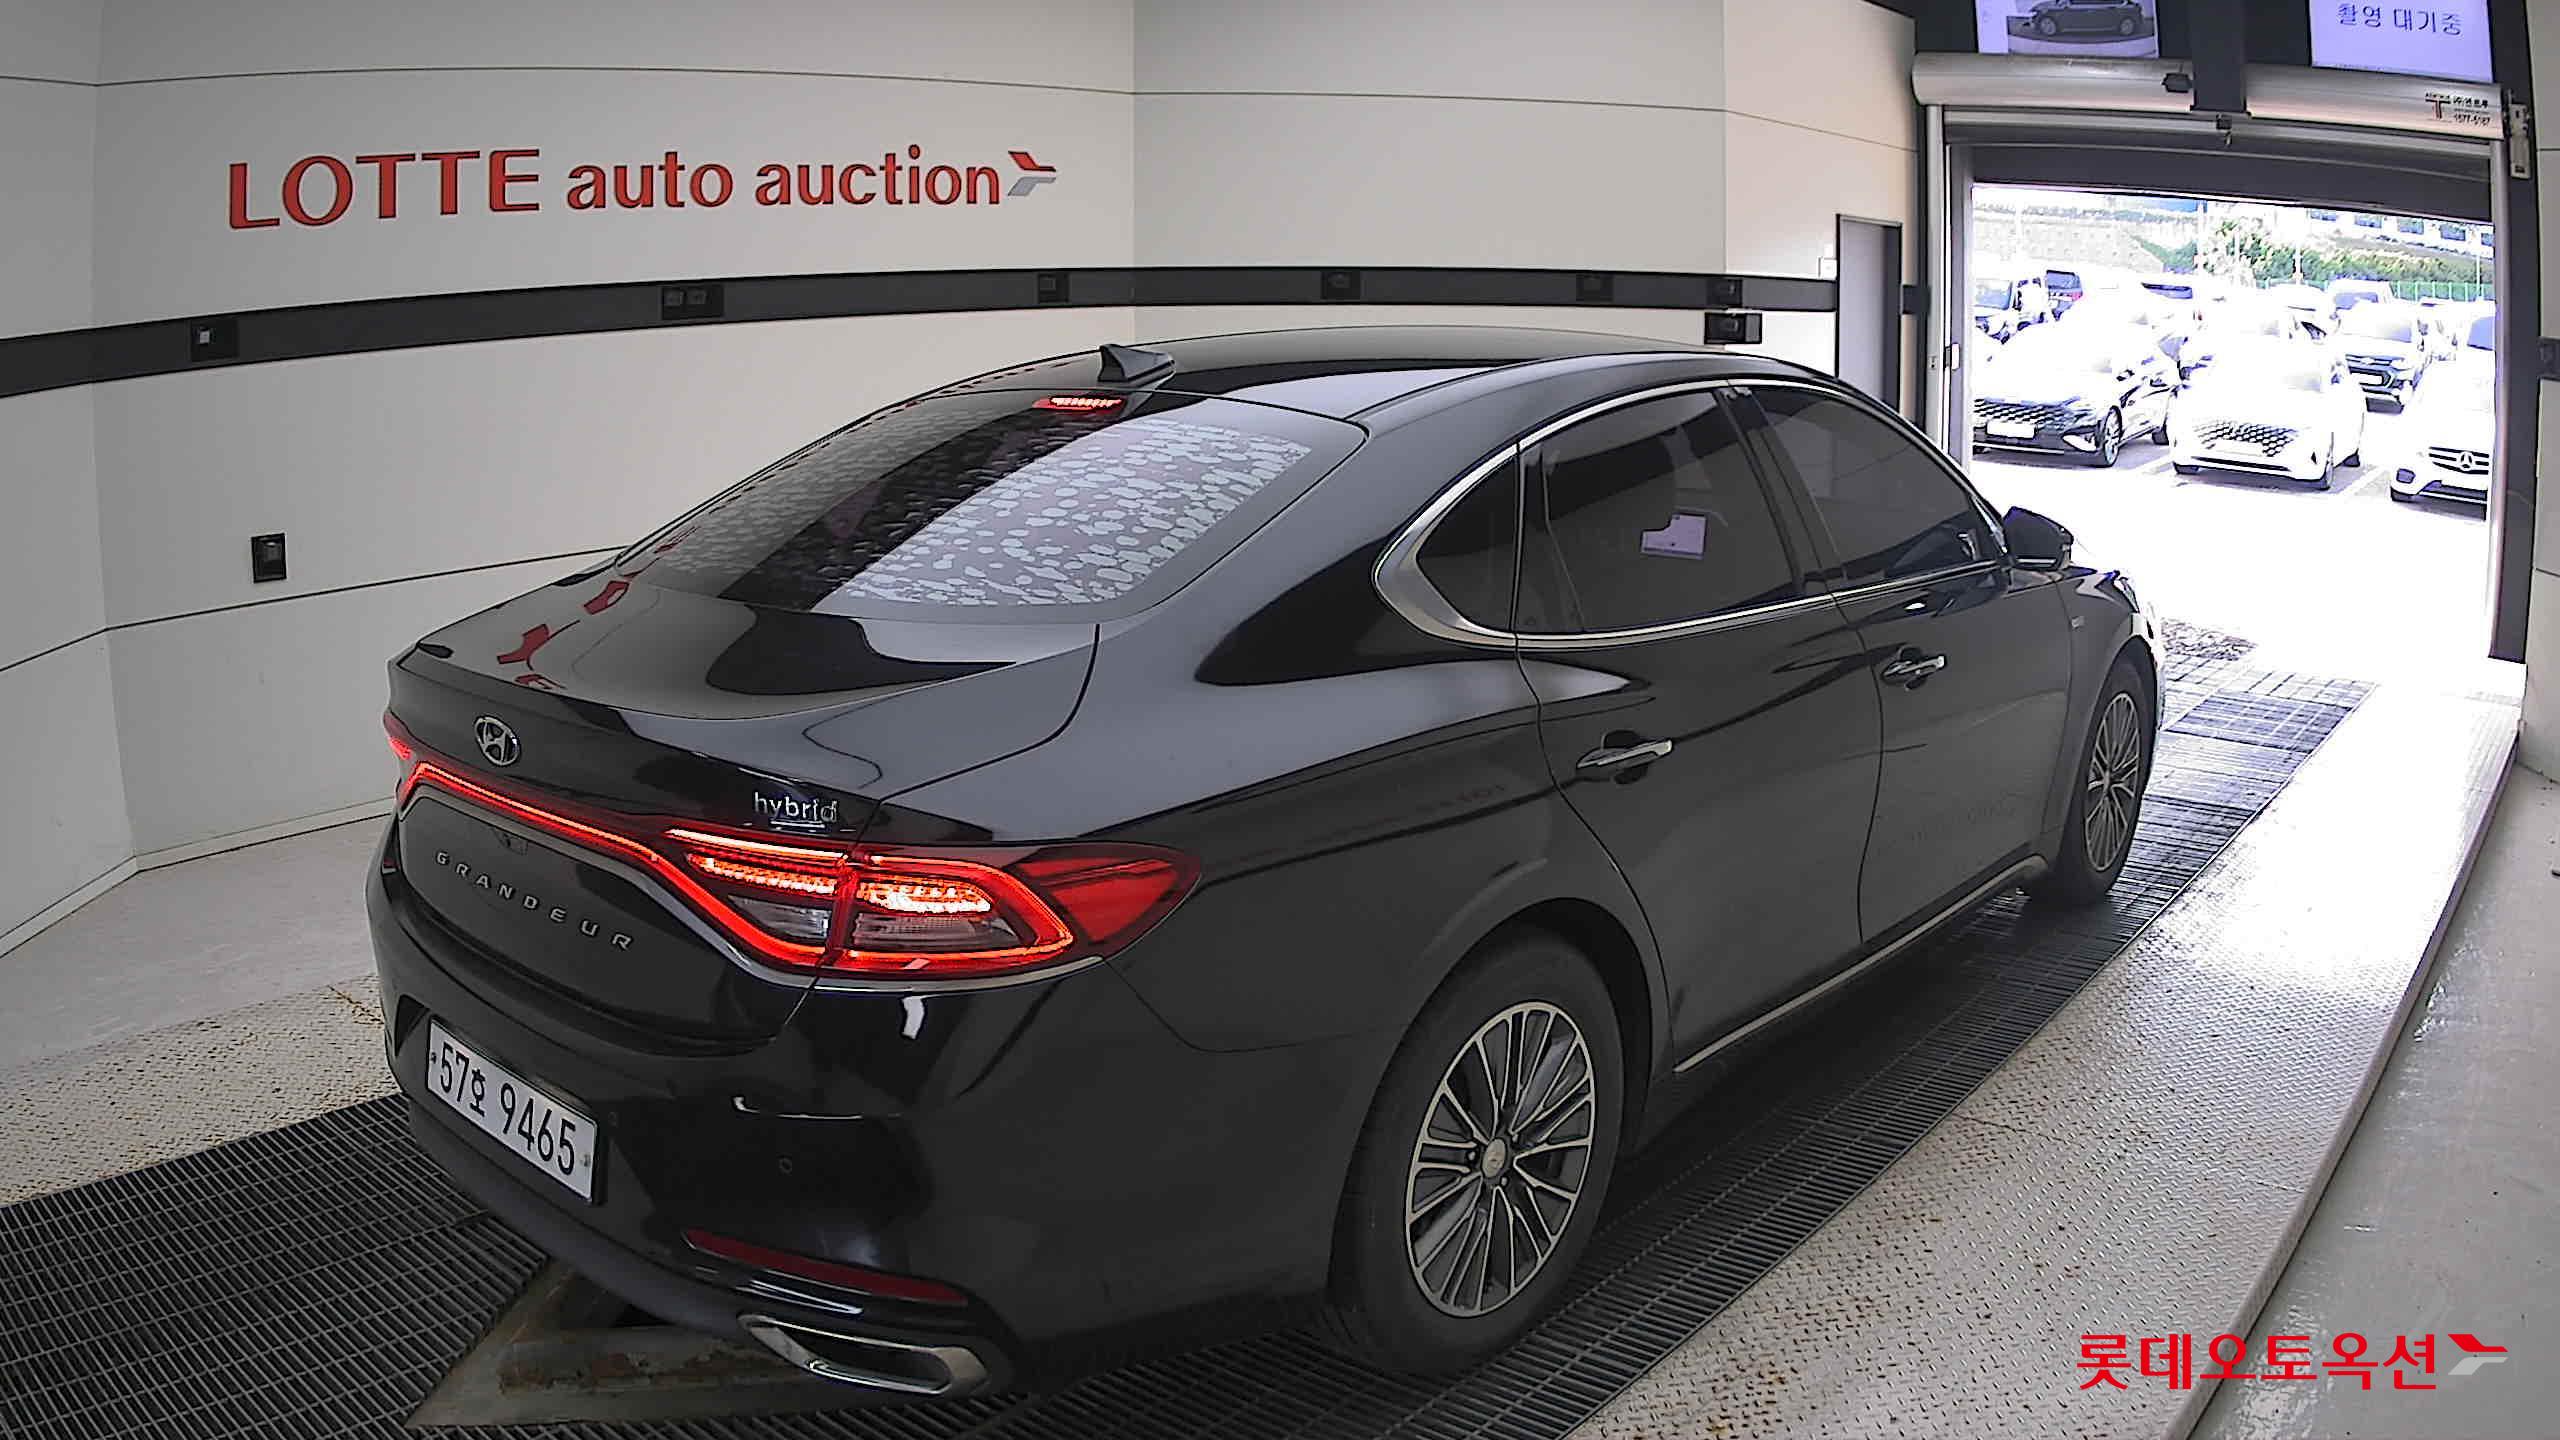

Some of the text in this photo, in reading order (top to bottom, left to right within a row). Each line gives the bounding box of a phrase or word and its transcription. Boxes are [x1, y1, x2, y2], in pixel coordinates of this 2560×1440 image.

[2338, 4, 2462, 36] 촬영 대기중
[229, 144, 1002, 230] LOTTE auto auction
[753, 790, 839, 823] hybrid
[435, 851, 633, 950] GRANDEUR
[439, 1041, 576, 1176] 57호 9465
